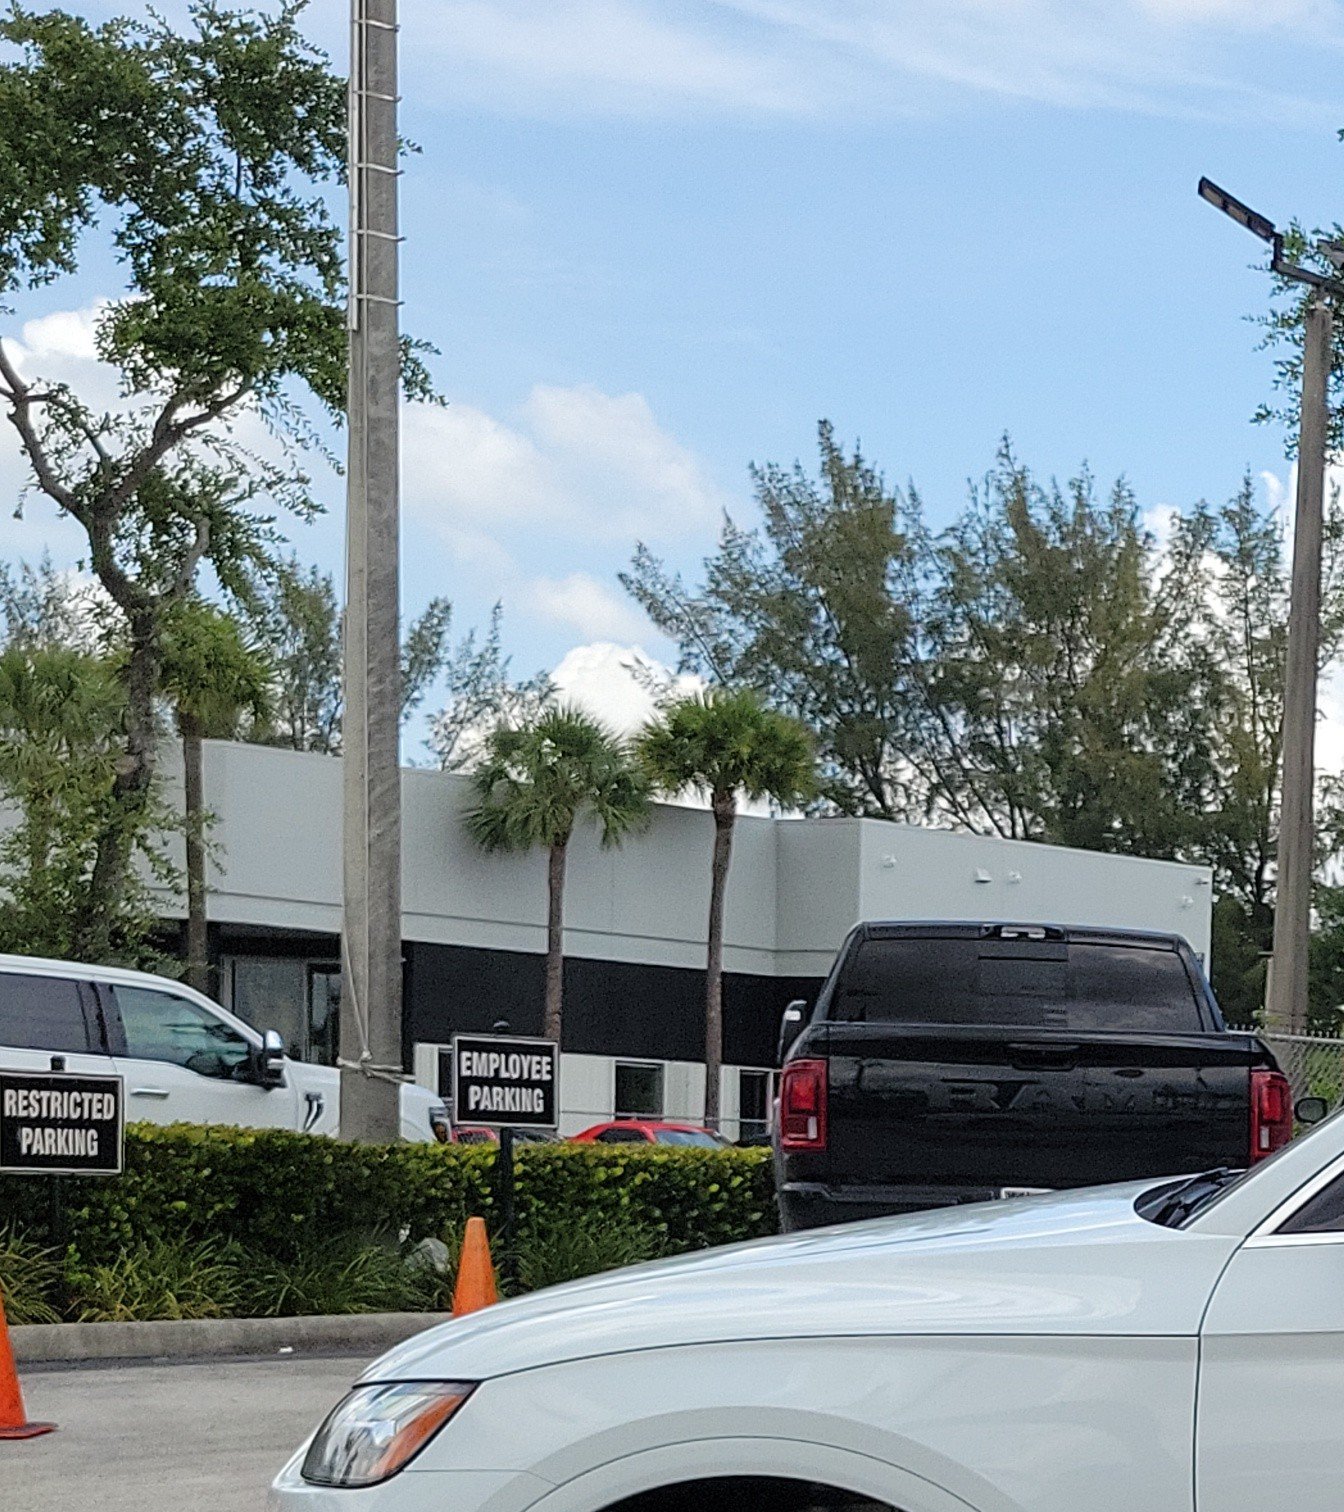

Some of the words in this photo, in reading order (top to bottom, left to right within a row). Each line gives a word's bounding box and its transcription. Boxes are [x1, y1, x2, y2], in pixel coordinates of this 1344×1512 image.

[460, 1050, 552, 1081] EMPLOYEE
[3, 1088, 115, 1120] RESTRICTED
[468, 1084, 544, 1113] PARKING
[20, 1127, 99, 1157] PARKING
